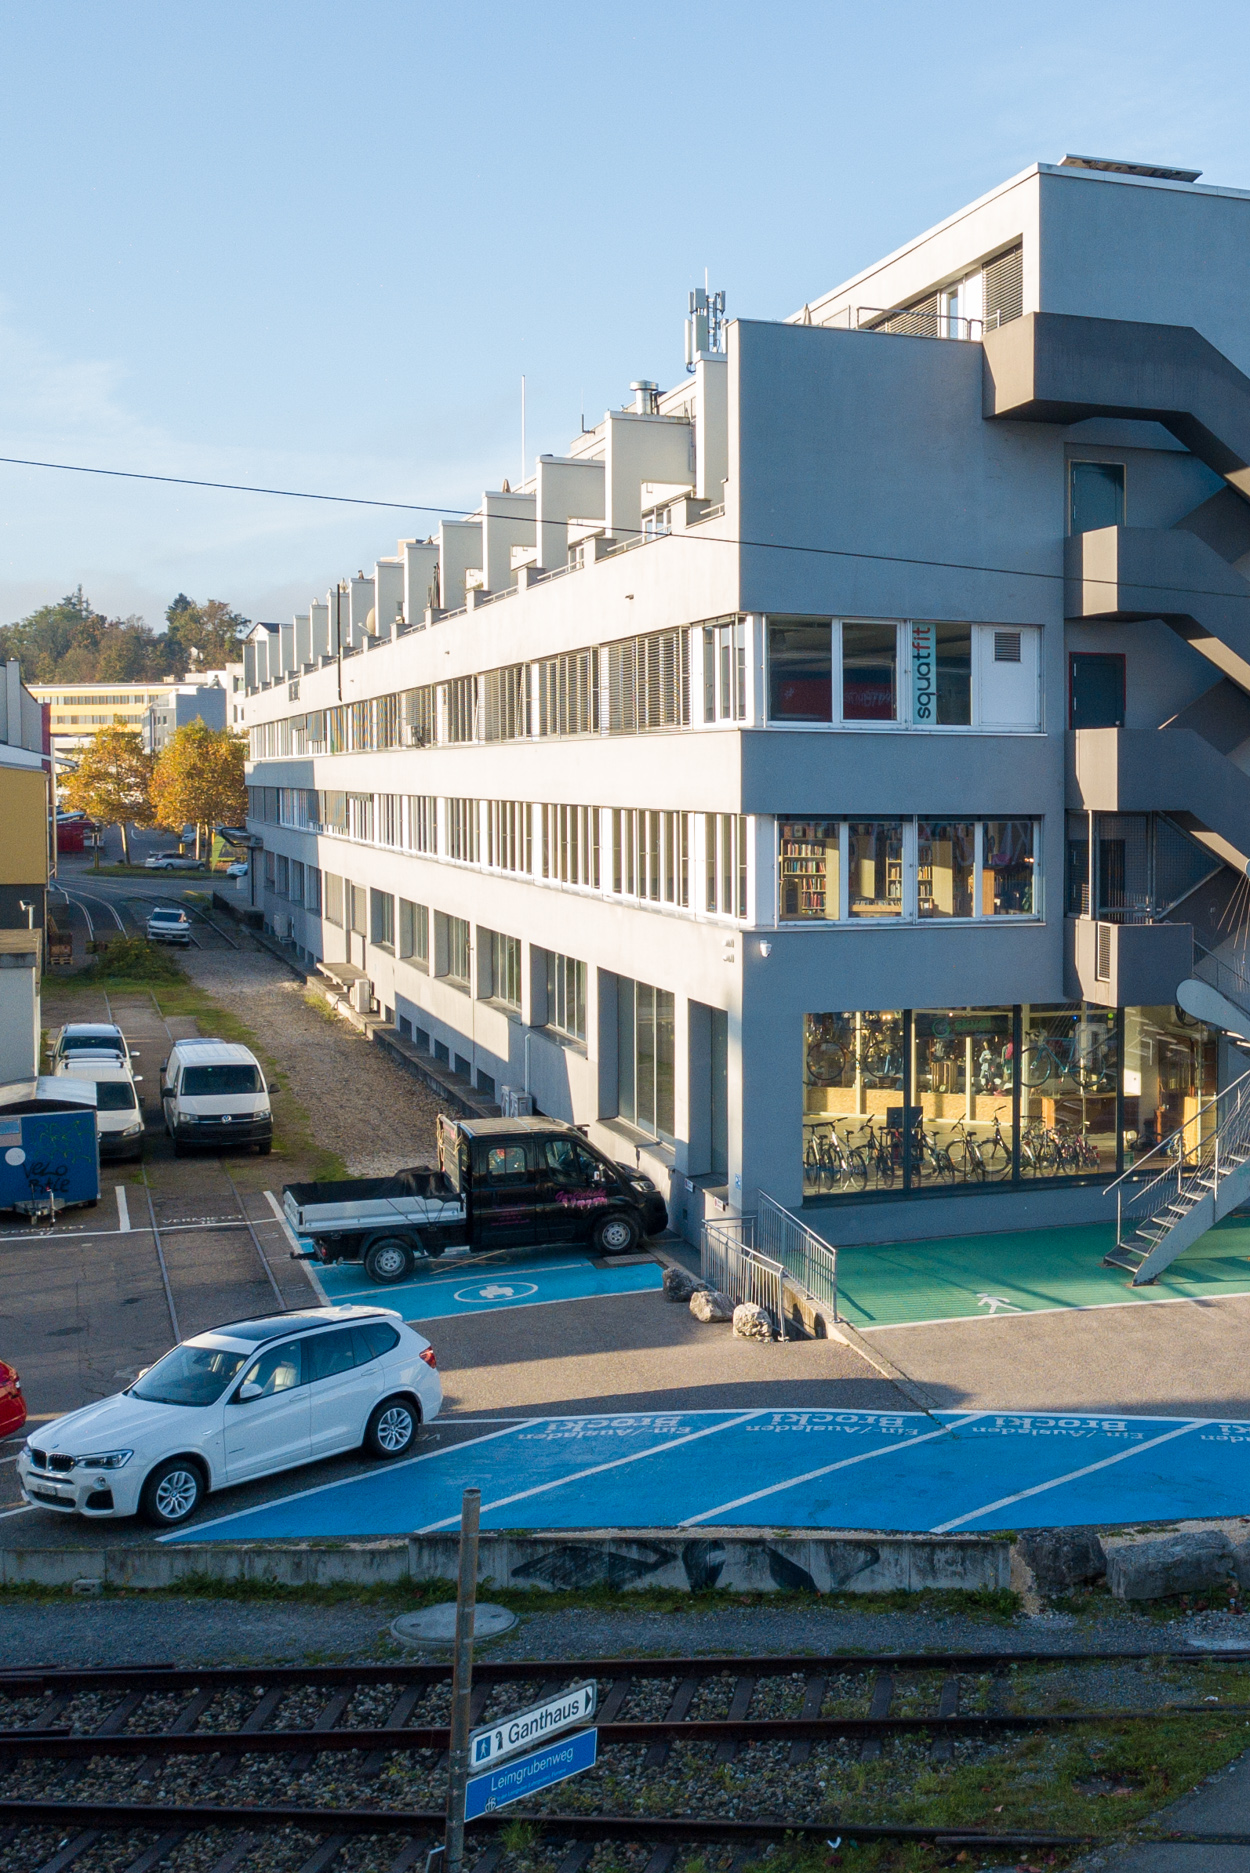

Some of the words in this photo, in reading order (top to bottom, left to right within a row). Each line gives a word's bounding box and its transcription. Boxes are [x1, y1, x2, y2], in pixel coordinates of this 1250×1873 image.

[912, 626, 935, 719] squatfit
[544, 1415, 683, 1433] Brocki
[770, 1413, 907, 1428] Brocki
[994, 1416, 1128, 1432] Brocki
[507, 1699, 580, 1745] Ganthaus
[491, 1746, 575, 1792] Leimgrubenweg
